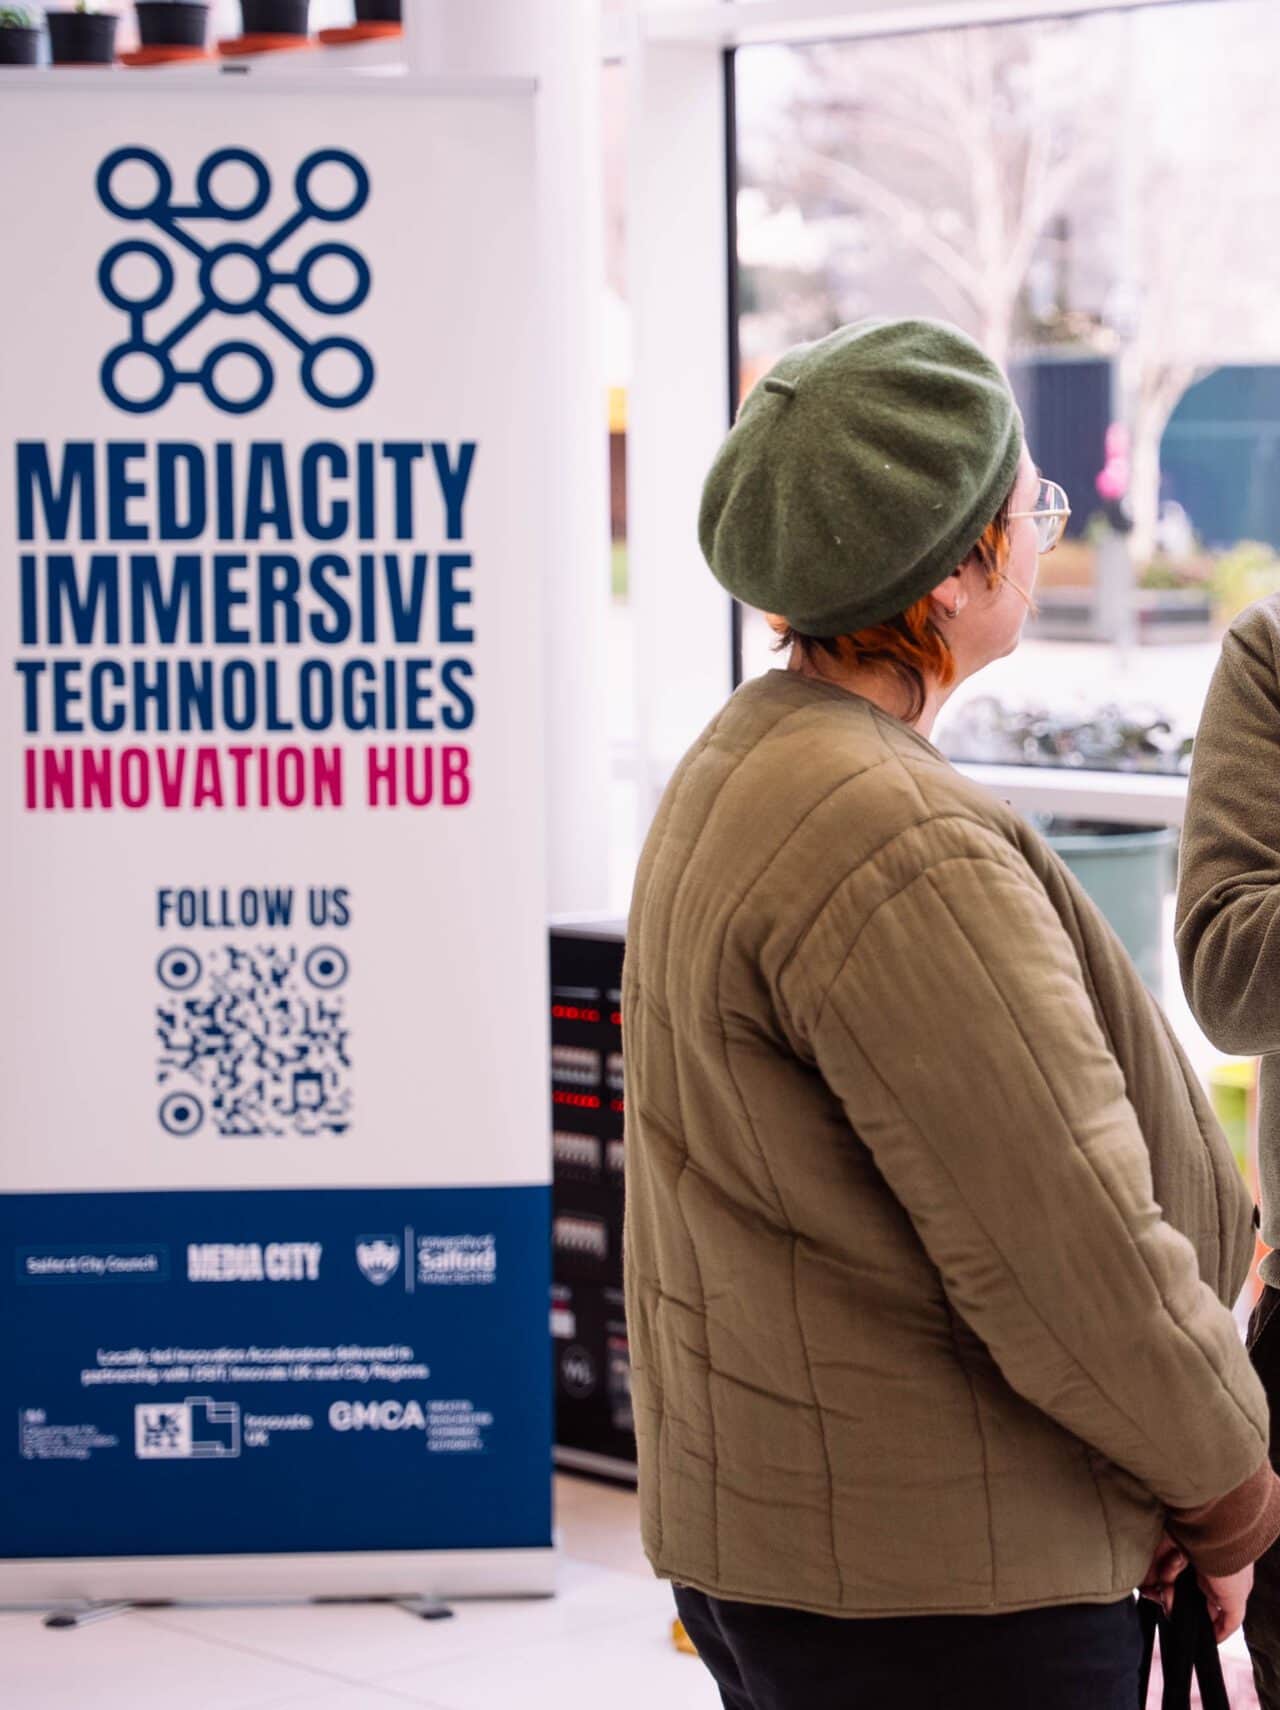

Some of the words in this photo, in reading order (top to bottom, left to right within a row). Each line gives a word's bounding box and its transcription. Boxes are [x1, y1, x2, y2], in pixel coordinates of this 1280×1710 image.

[16, 441, 476, 541] MEDIACITY
[20, 553, 474, 645] IMMERSIVE
[15, 658, 475, 733] TECHNOLOGIES
[25, 746, 342, 809] INNOVATION
[367, 746, 470, 807] HUB
[157, 888, 294, 928] FOLLOW
[307, 887, 350, 928] US
[187, 1242, 263, 1281] MEDIA
[264, 1241, 322, 1280] CITY
[418, 1247, 496, 1271] Salford
[328, 1400, 426, 1432] GMCA
